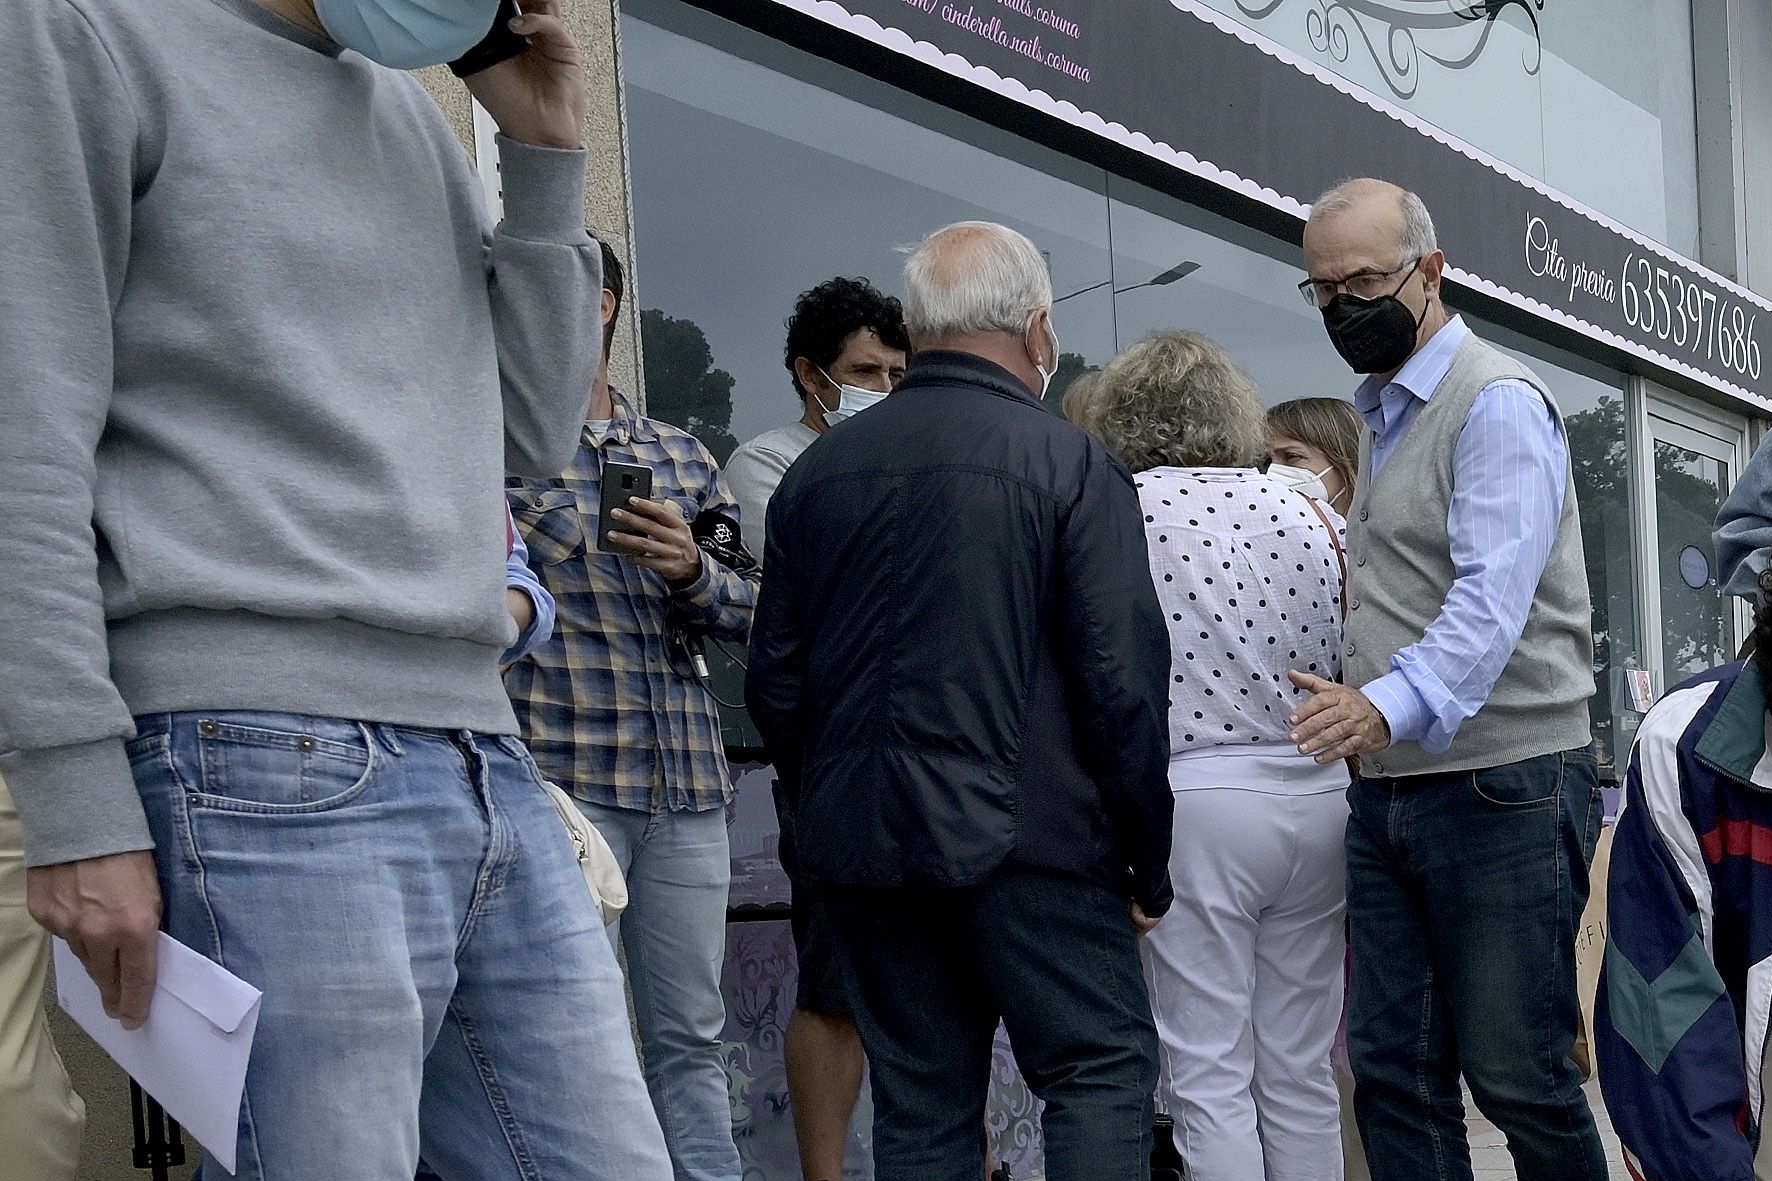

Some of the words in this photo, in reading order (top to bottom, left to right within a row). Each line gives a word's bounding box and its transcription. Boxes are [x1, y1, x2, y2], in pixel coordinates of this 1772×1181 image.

[1525, 212, 1568, 282] Cita
[1569, 261, 1616, 304] previa
[1621, 252, 1761, 381] 635397686
